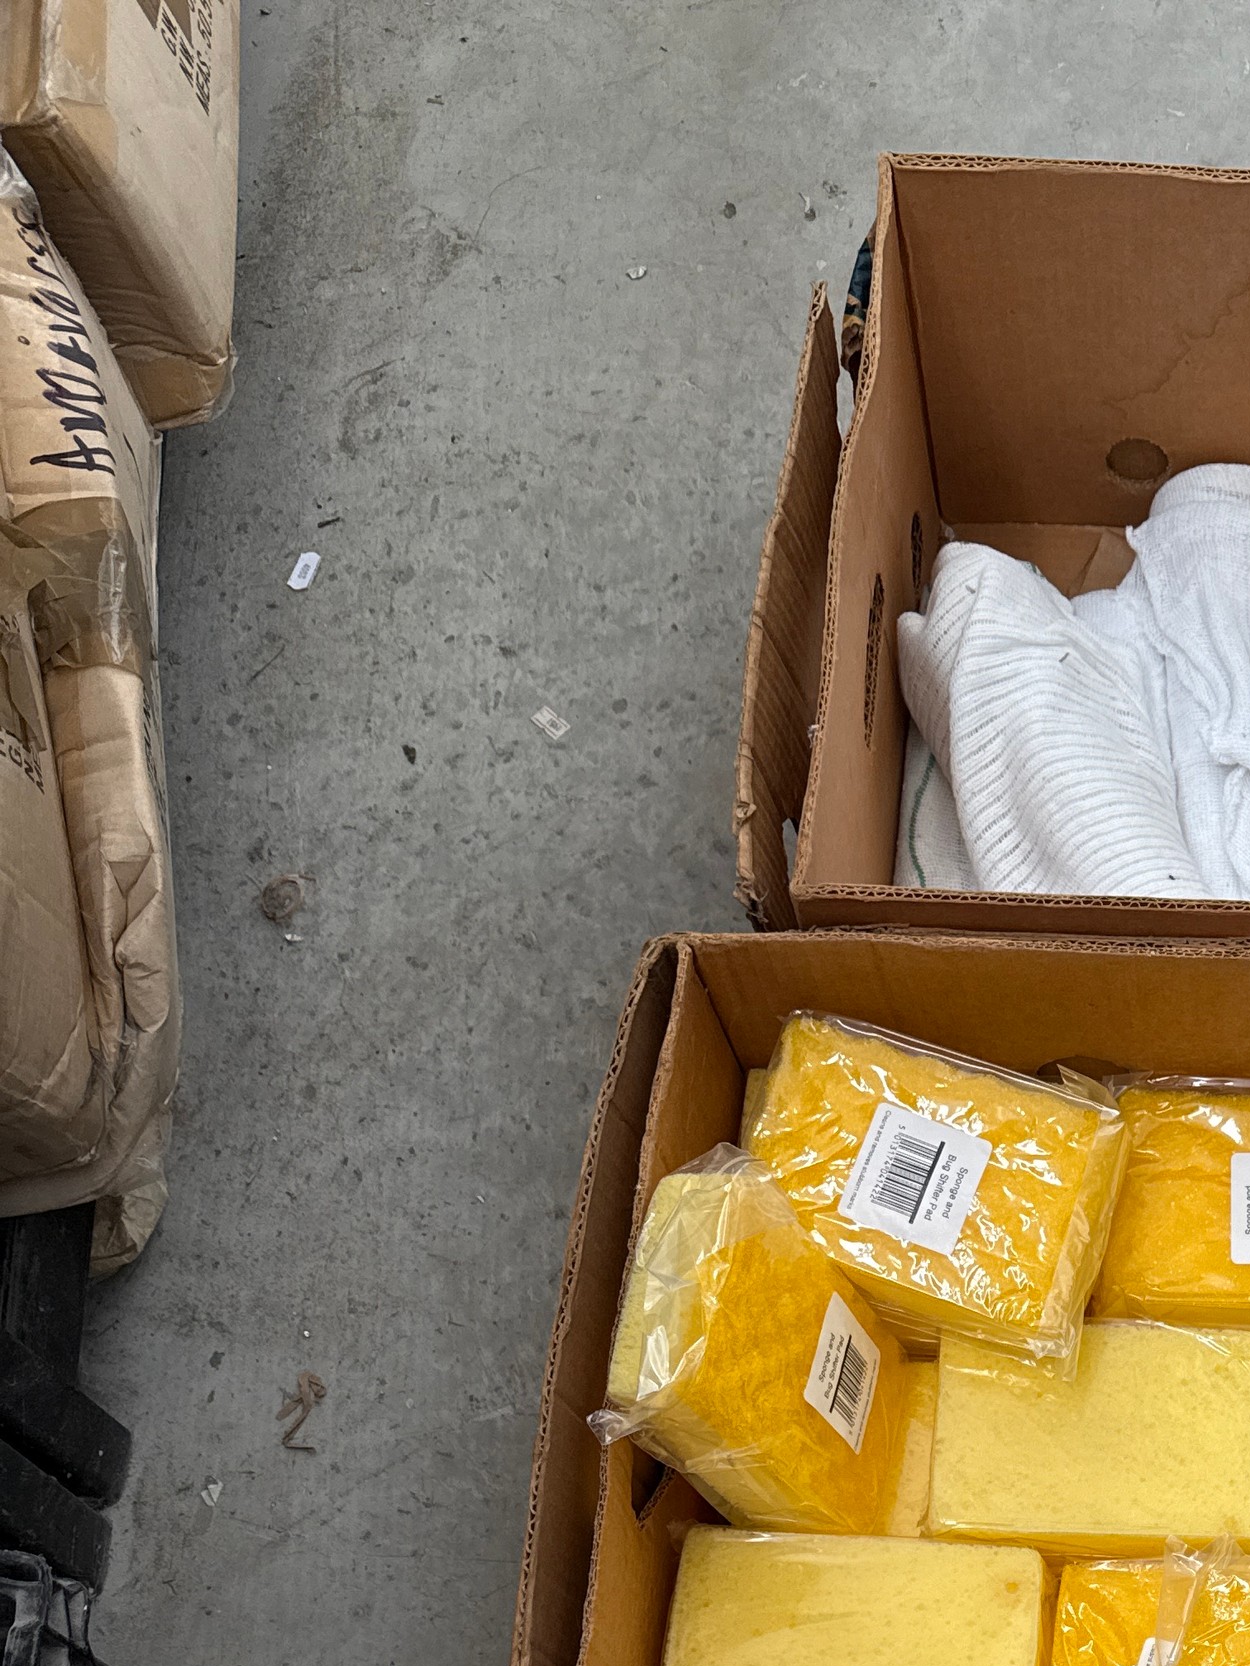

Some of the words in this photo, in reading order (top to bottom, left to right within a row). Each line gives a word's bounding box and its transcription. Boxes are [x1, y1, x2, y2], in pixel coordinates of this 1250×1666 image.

[883, 1133, 901, 1166] 013174
[941, 1153, 956, 1172] Bug
[869, 1167, 887, 1200] 041422
[931, 1172, 949, 1201] Shifter
[947, 1166, 968, 1201] Sponge
[923, 1202, 937, 1221] Pad
[941, 1200, 954, 1219] and
